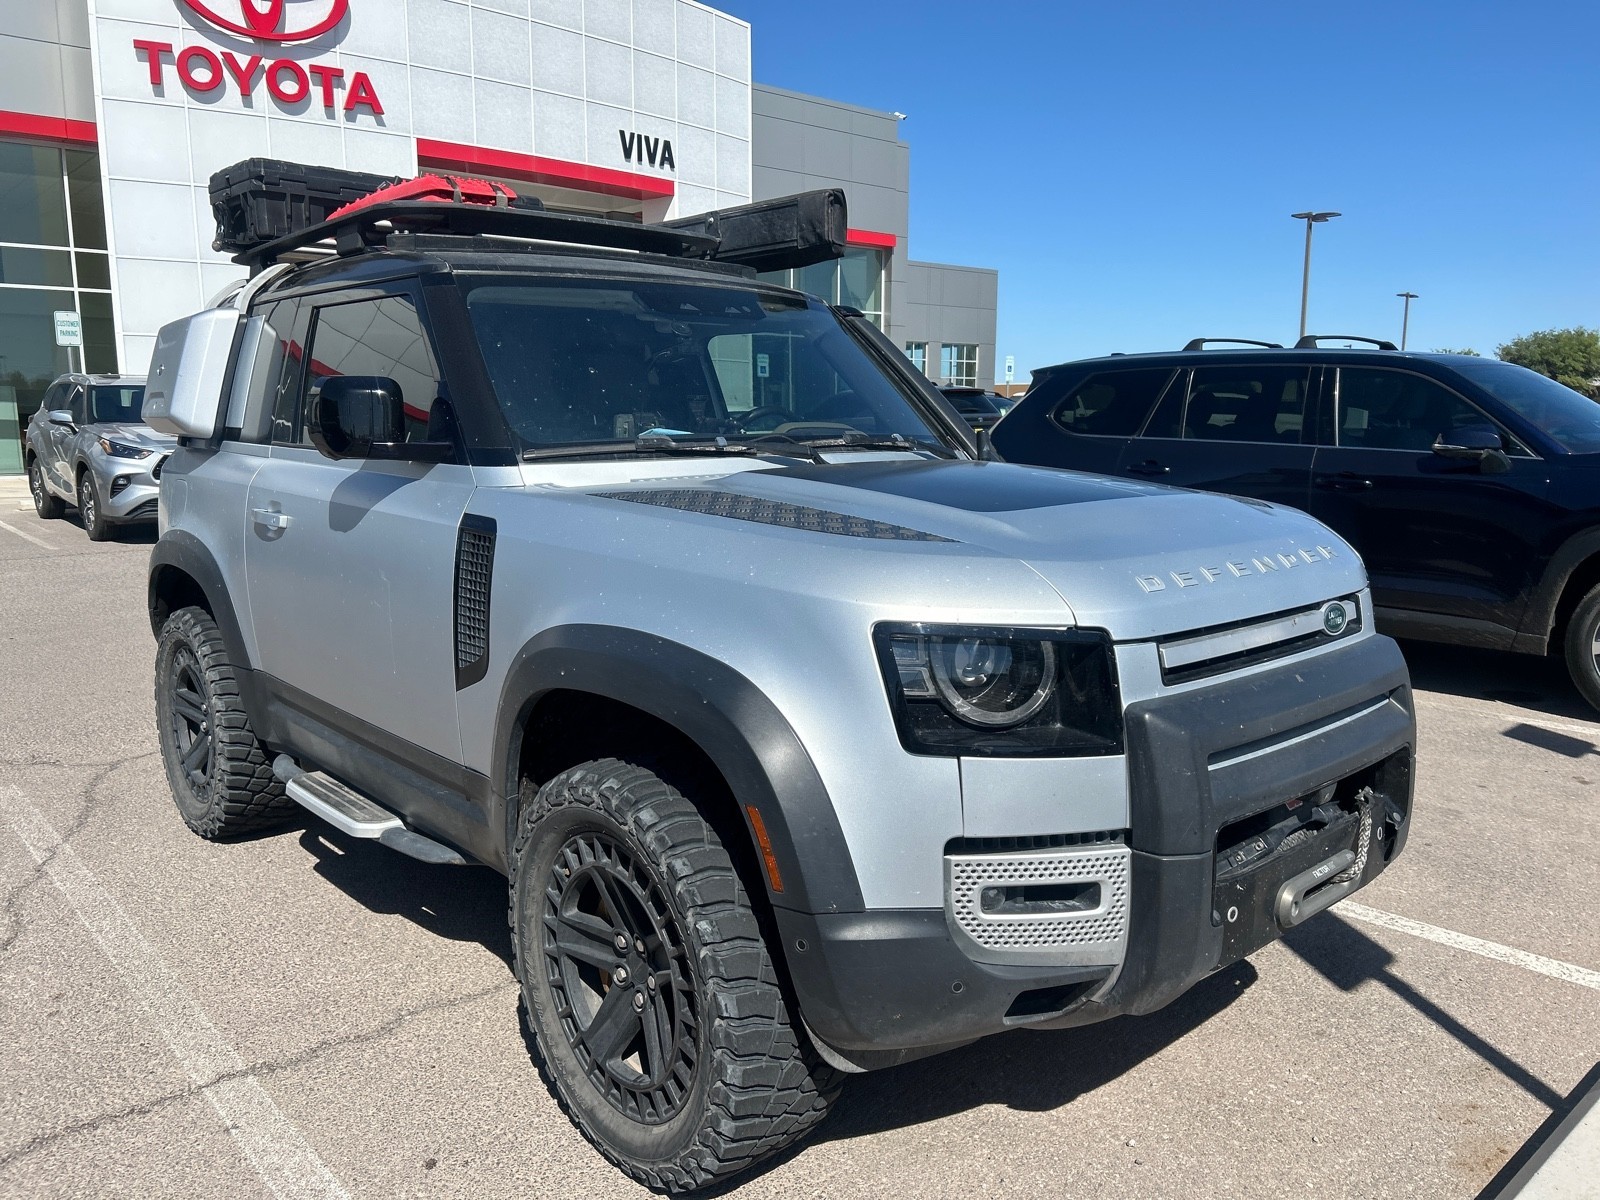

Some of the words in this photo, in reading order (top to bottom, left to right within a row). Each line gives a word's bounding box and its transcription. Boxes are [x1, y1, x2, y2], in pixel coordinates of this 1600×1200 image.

[133, 39, 385, 115] TOYOTA
[619, 129, 675, 169] VIVA
[1135, 545, 1338, 593] DEFENDER
